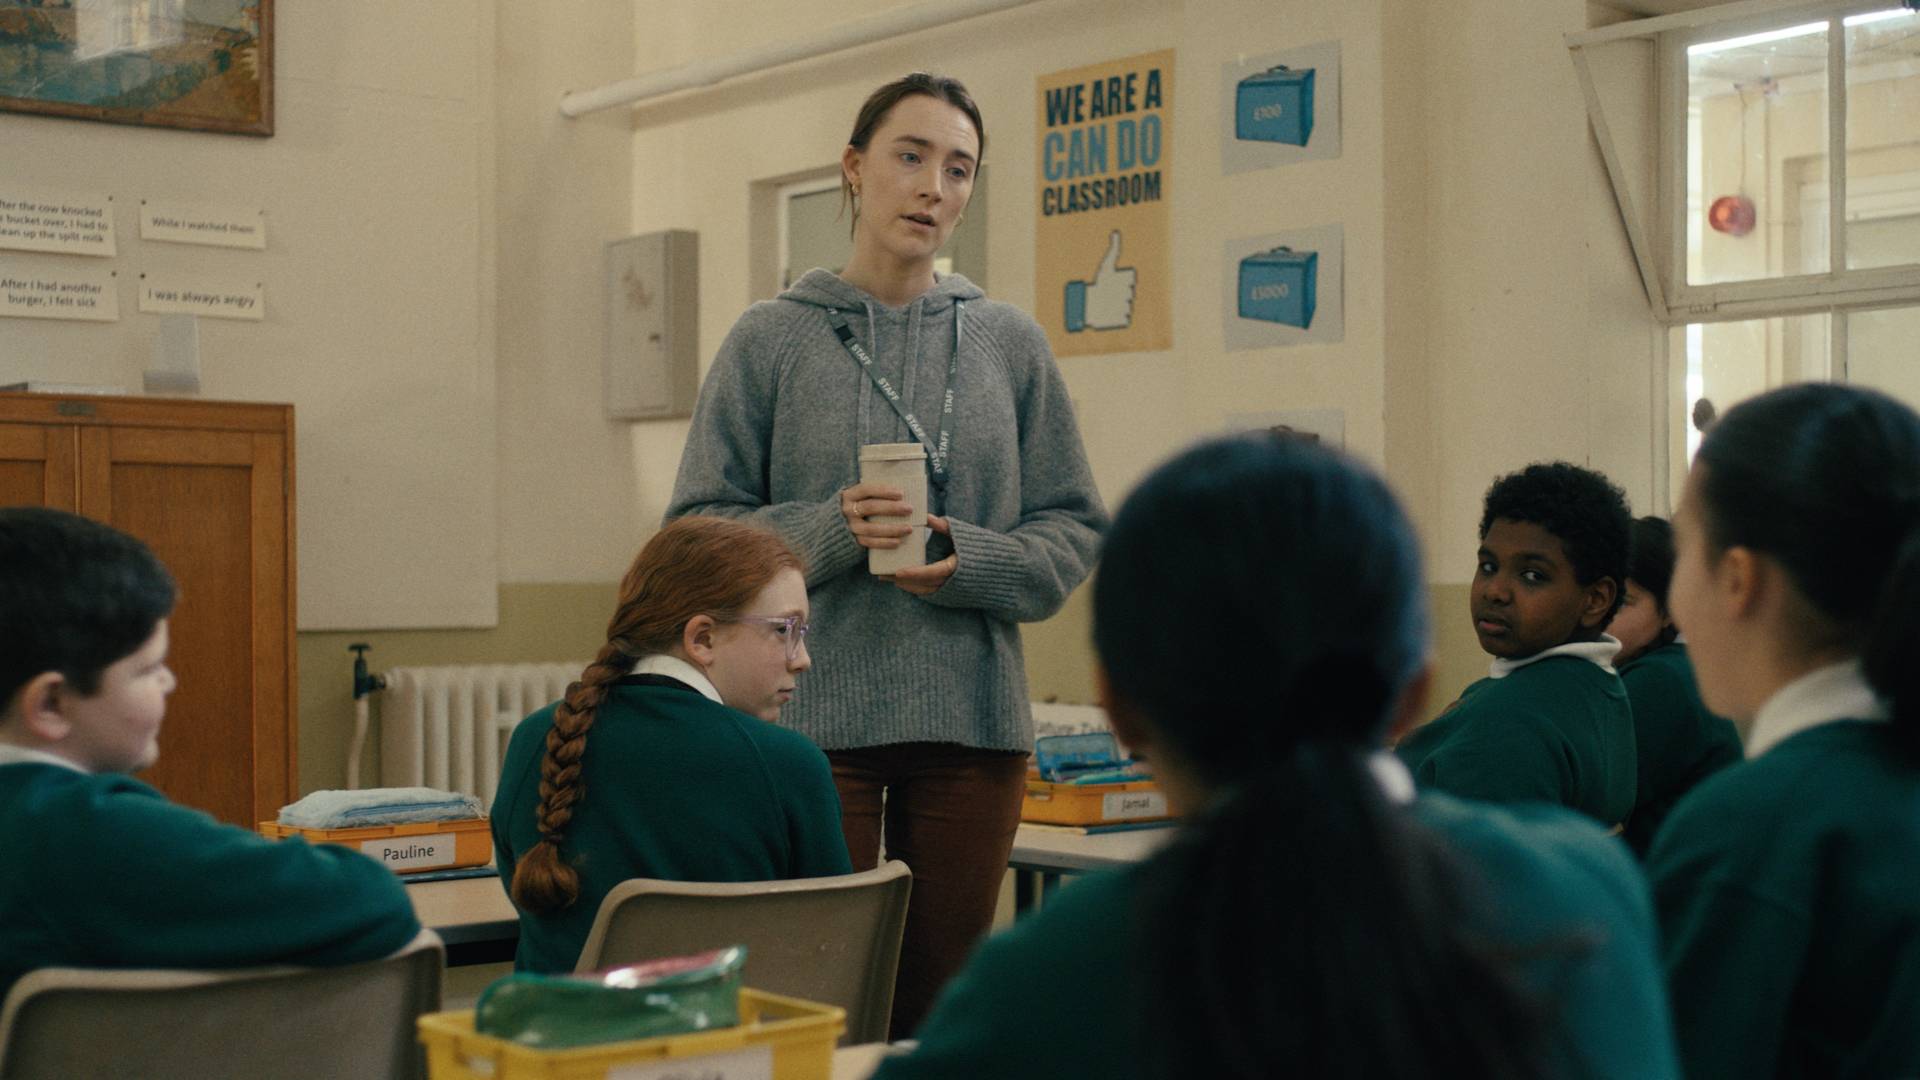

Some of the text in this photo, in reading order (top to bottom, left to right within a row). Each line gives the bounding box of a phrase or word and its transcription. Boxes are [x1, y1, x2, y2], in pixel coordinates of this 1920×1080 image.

[1046, 69, 1163, 127] WE ARE A
[1043, 114, 1162, 182] CAN DO
[1043, 171, 1161, 216] CLASSROOM
[19, 202, 36, 211] the
[38, 205, 59, 213] cow
[62, 206, 102, 217] knocked
[7, 214, 40, 224] bucket
[76, 220, 95, 230] had
[98, 222, 108, 231] to
[152, 217, 179, 228] While
[188, 221, 228, 232] watched
[23, 231, 36, 240] up
[40, 230, 55, 239] the
[82, 234, 103, 243] milk
[0, 279, 27, 289] After
[37, 280, 57, 291] had
[61, 283, 101, 294] another
[56, 295, 73, 305] felt
[77, 297, 96, 307] sick
[155, 291, 177, 302] was
[182, 291, 221, 306] always
[224, 295, 255, 309] angry
[851, 343, 873, 366] STAFF
[878, 377, 900, 401] STAFF
[944, 388, 954, 414] STAFF
[905, 414, 926, 438] STAFF
[939, 430, 950, 458] STAFF
[931, 452, 944, 474] STAF
[1121, 796, 1151, 812] Jamal
[384, 845, 435, 861] Pauline
